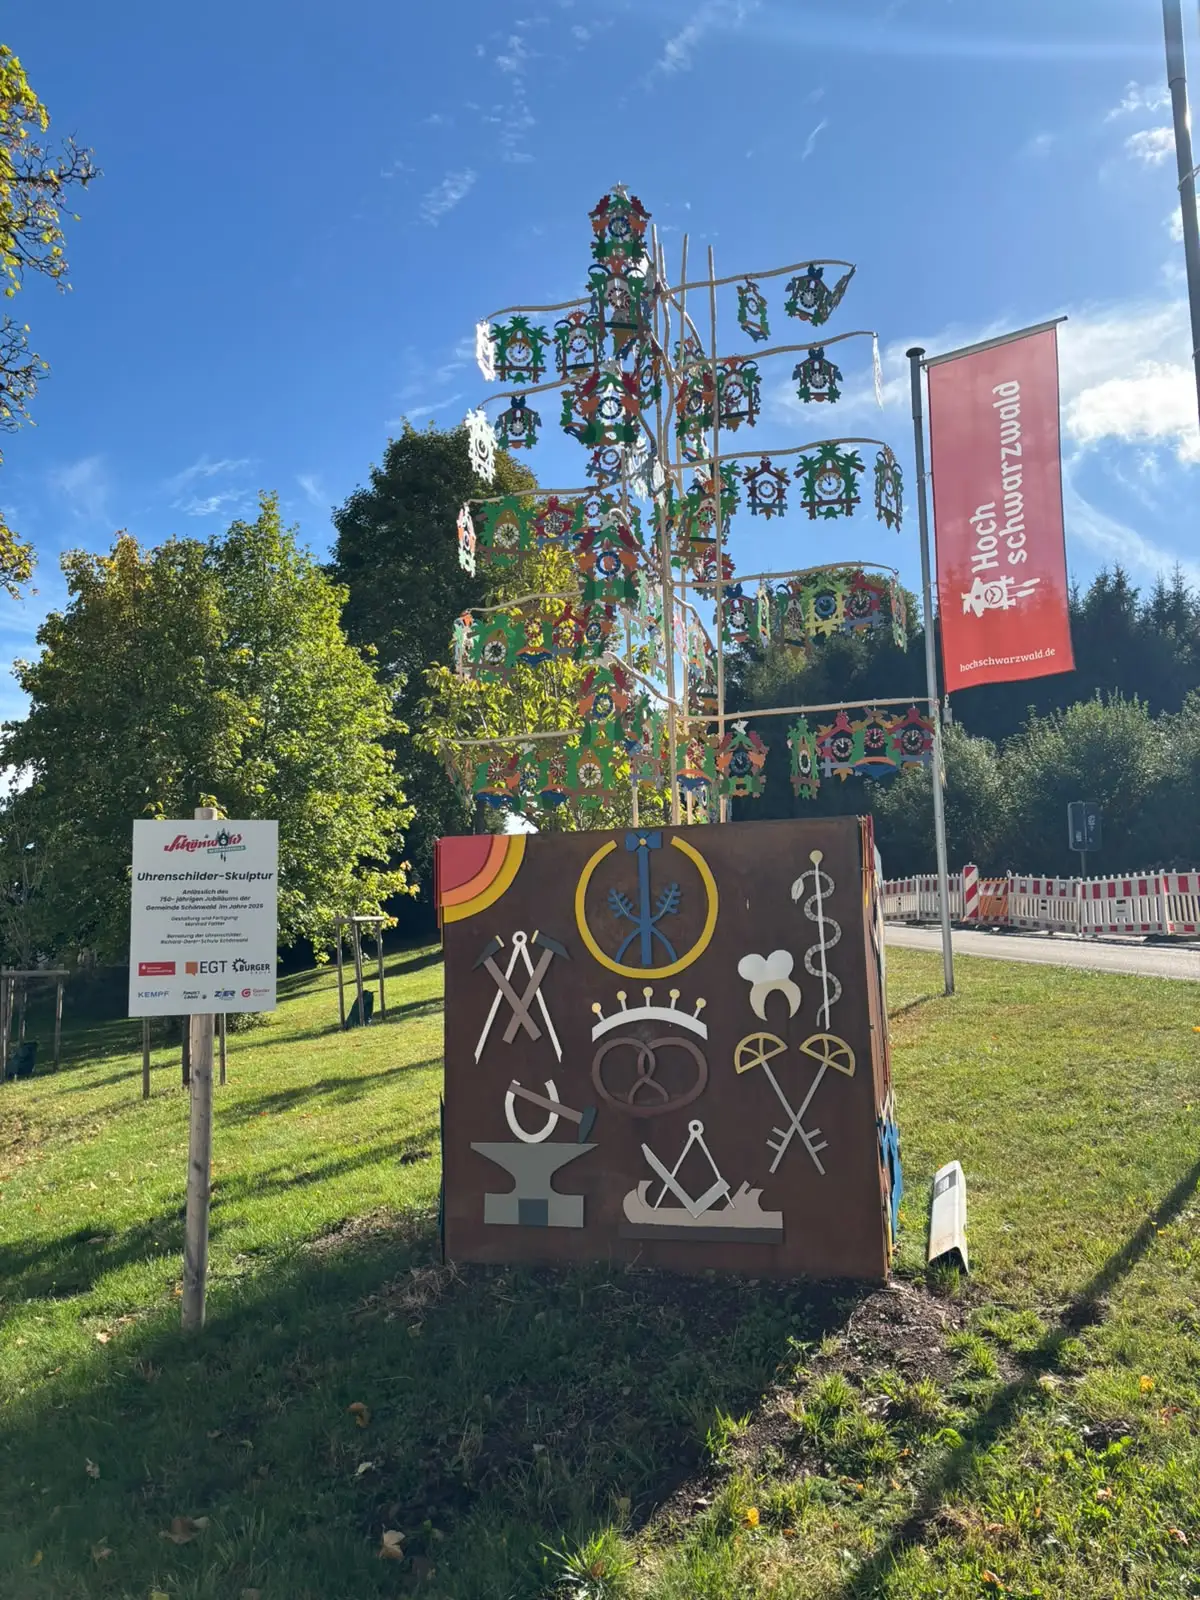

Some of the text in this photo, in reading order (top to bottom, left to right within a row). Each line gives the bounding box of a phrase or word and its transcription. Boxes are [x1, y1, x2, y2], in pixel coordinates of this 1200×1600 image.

[992, 379, 1028, 565] schwarzwald
[969, 501, 999, 573] Hoch
[959, 647, 1056, 673] hochschwarzwald.de
[137, 871, 274, 882] Uhrenschilder-Skulptur
[175, 896, 204, 904] jährigen
[200, 960, 271, 974] EGT BURGER
[138, 990, 169, 998] KEMPF
